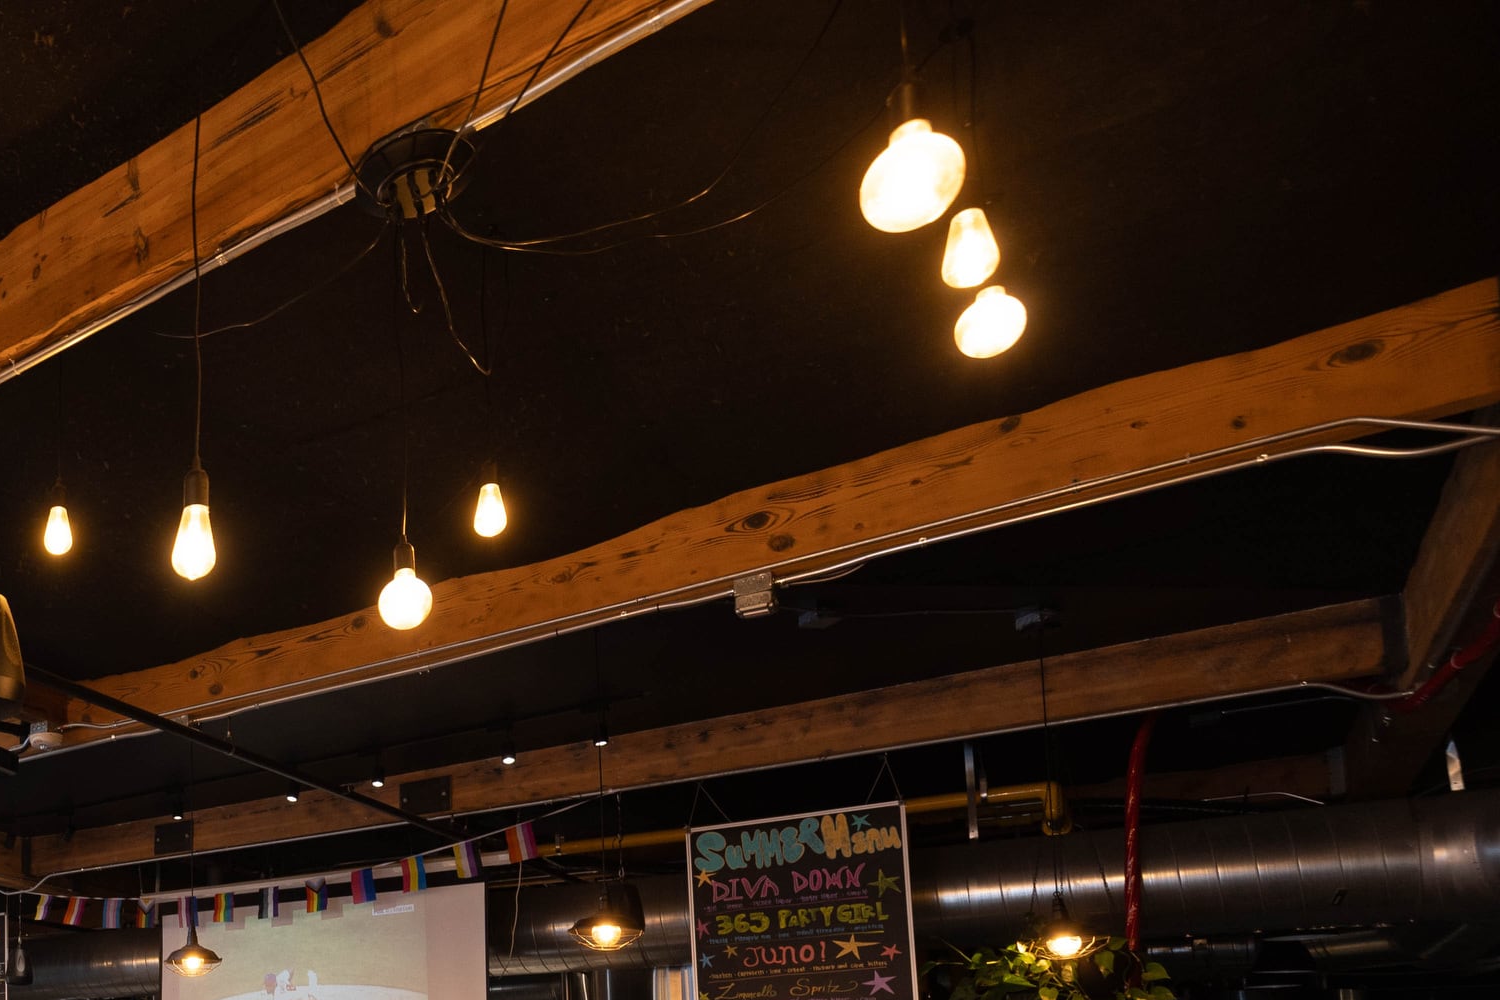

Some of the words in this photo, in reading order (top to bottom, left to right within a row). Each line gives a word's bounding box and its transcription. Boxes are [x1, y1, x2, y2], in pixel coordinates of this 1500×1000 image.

[711, 875, 779, 903] DIVA
[791, 863, 866, 893] DOWN
[715, 911, 771, 935] 365
[837, 901, 890, 923] GIRL
[789, 977, 859, 998] Spritz
